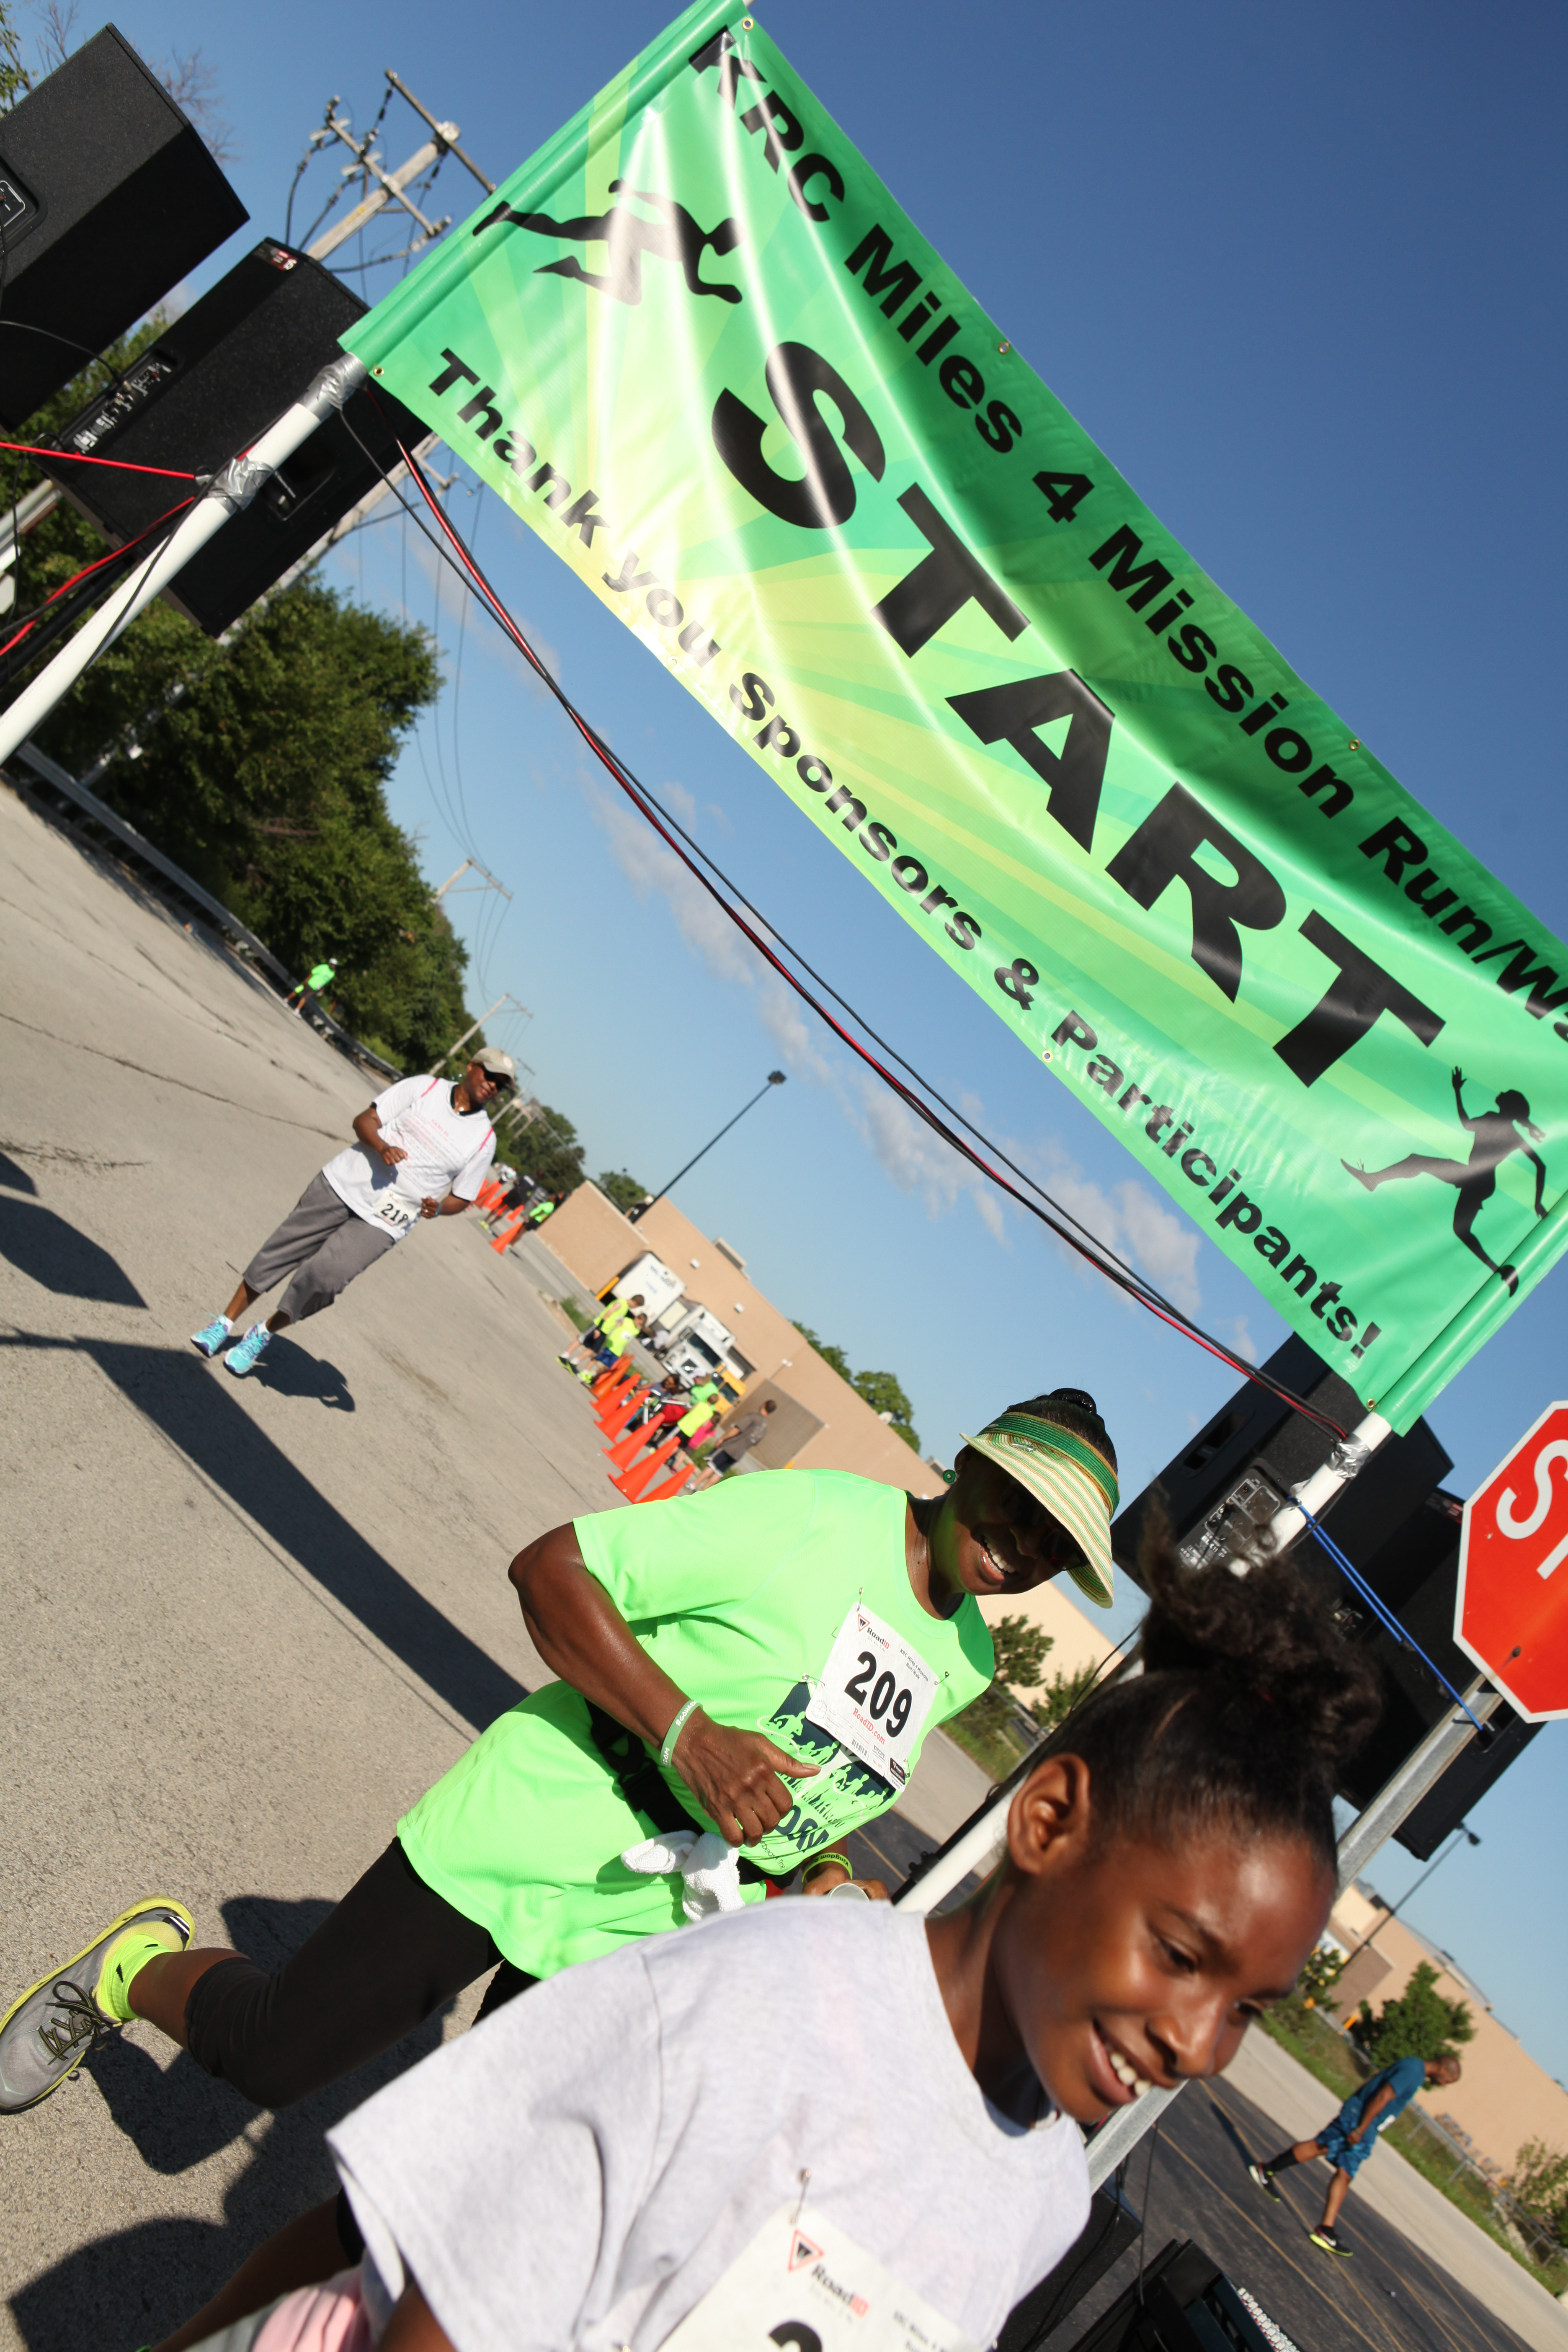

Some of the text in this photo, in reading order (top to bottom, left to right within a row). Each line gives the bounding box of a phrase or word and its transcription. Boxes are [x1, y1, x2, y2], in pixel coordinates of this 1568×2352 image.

[688, 25, 845, 222] KRC
[844, 223, 1023, 454] Miles
[1032, 471, 1094, 523] 4
[1088, 524, 1354, 819] Mission
[711, 340, 1446, 1088] START
[428, 348, 1382, 1359] Thank you Sponsors & Participants!
[867, 1627, 890, 1649] RoadID
[844, 1651, 912, 1738] 209
[906, 1662, 920, 1680] Run/Walk
[853, 1707, 885, 1745] RoadID.com
[820, 1854, 848, 1866] Kingdom
